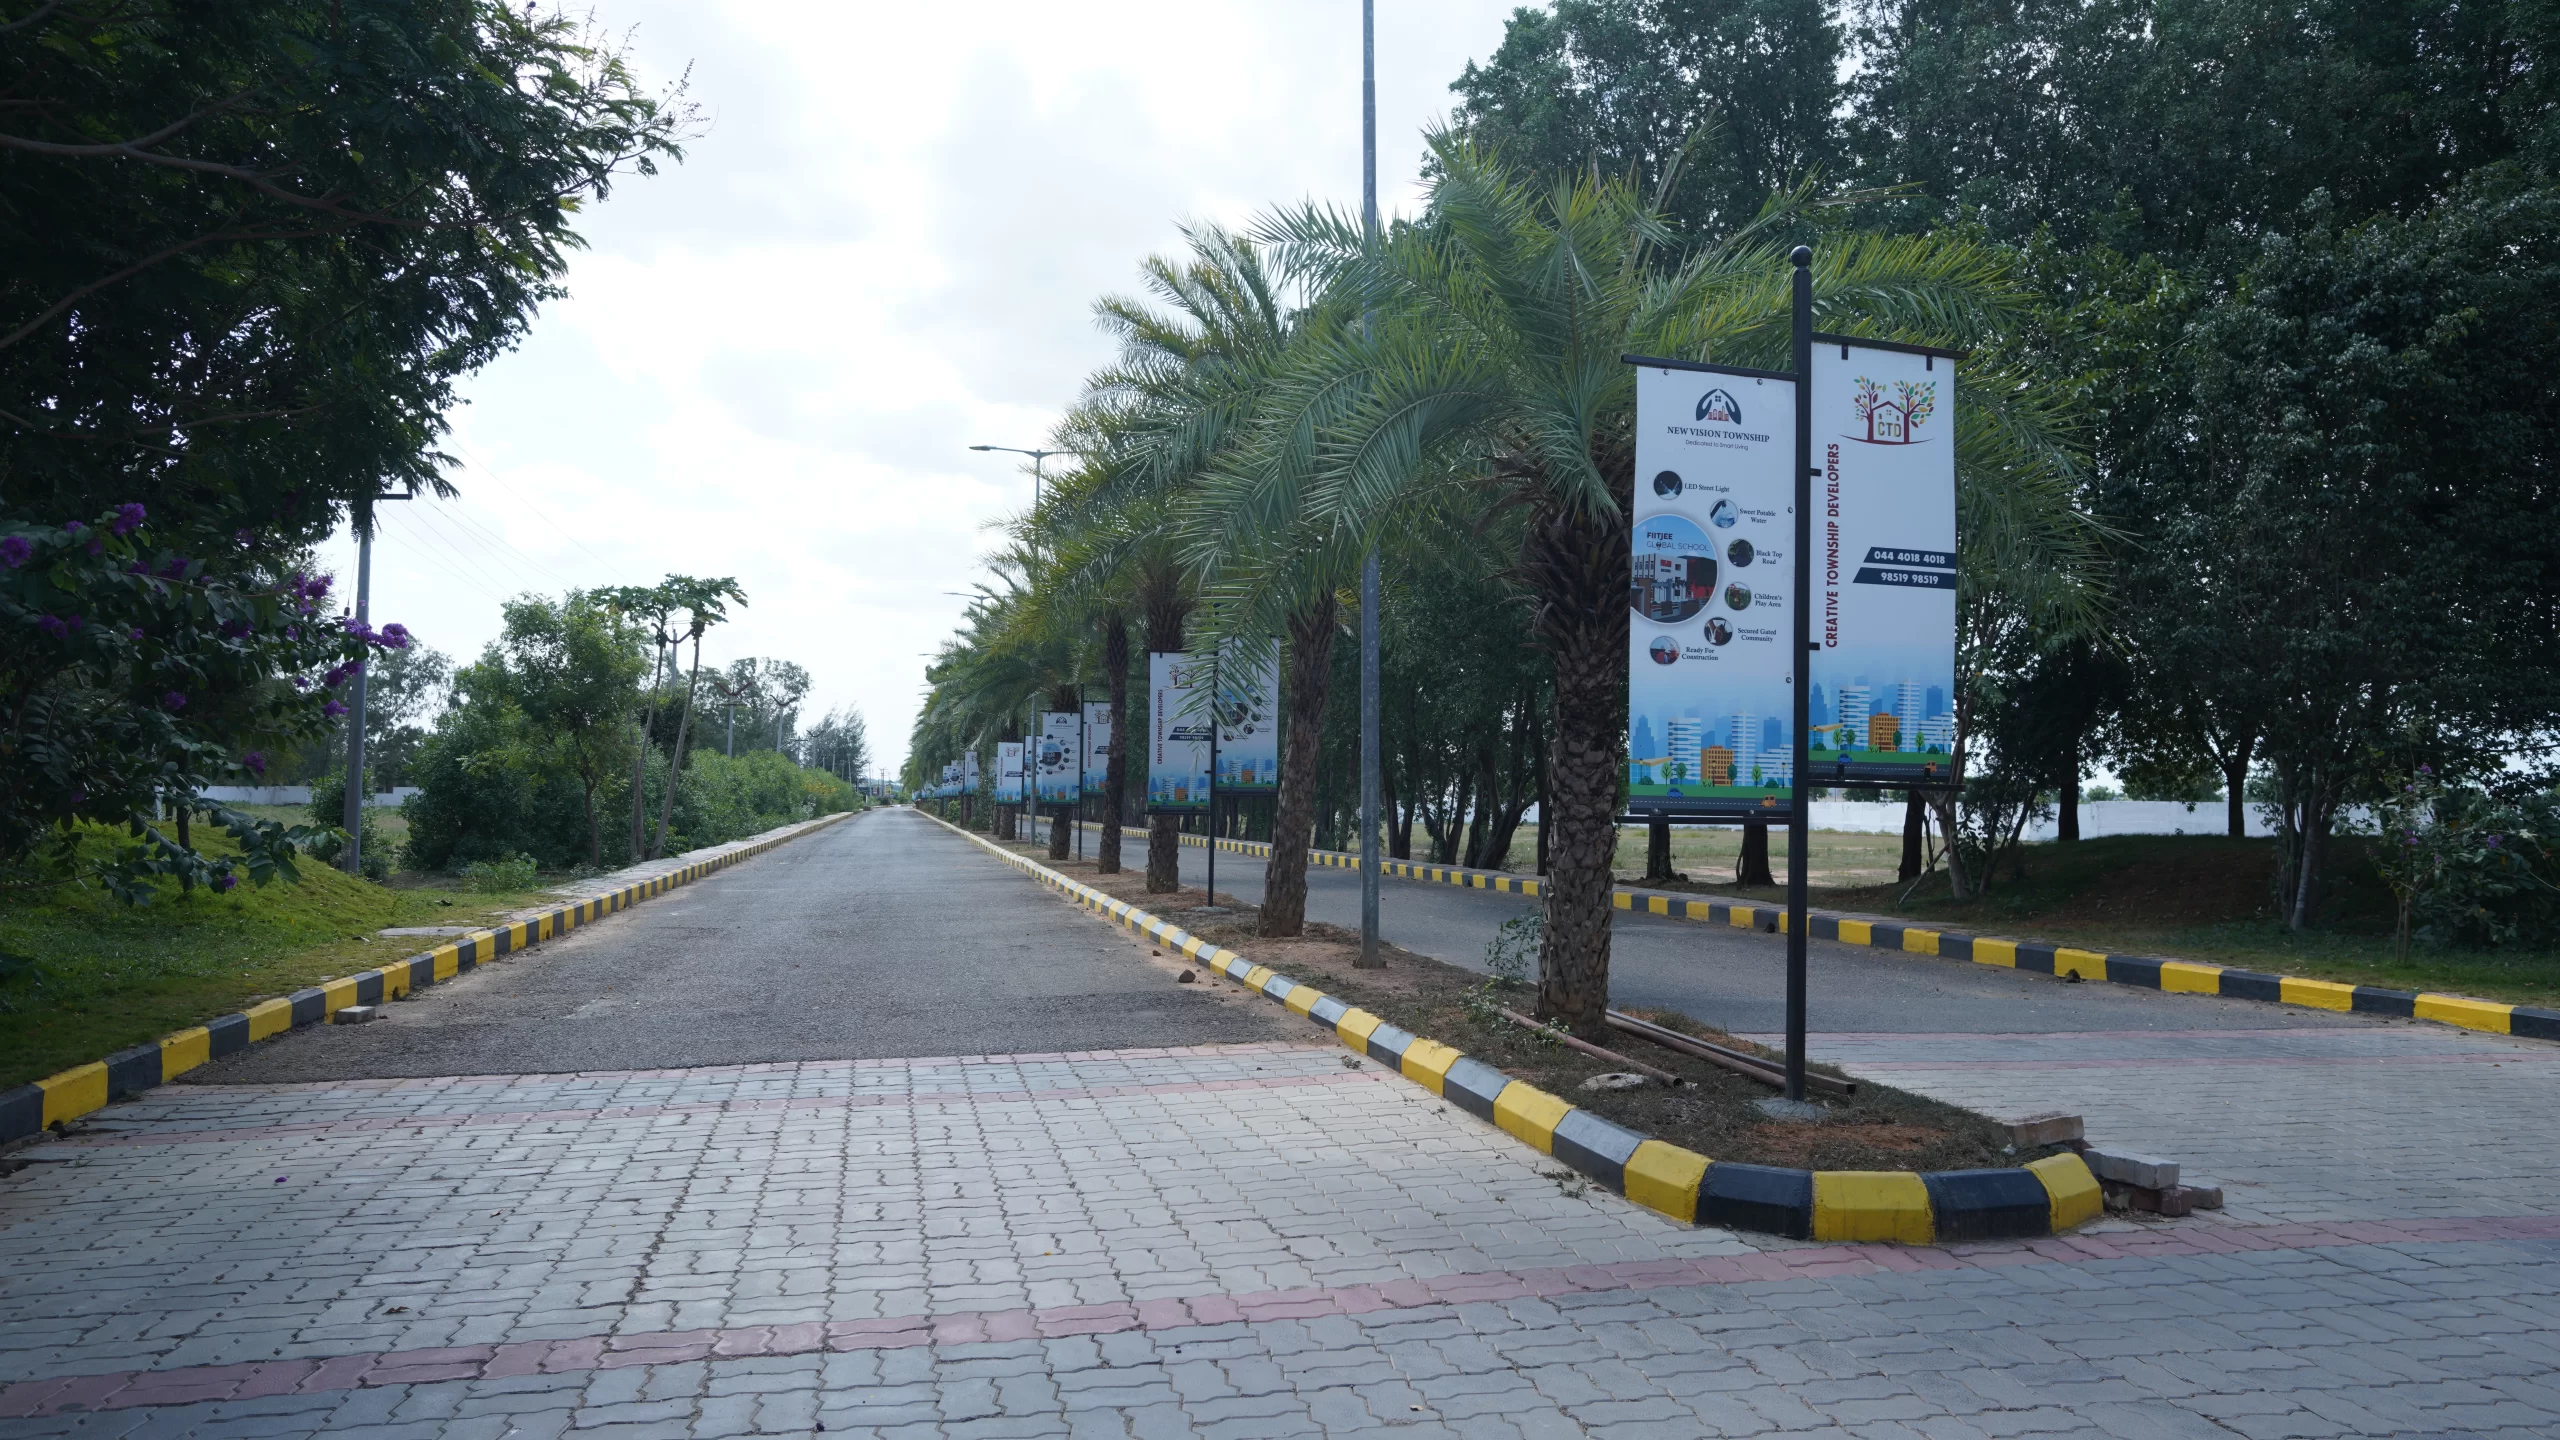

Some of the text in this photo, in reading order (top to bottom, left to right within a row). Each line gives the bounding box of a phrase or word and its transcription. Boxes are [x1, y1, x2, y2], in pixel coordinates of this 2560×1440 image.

[1878, 422, 1902, 437] CTD
[1667, 426, 1770, 443] NEW VISION TOWNSHIP
[1685, 439, 1712, 447] Dedicated
[1734, 443, 1749, 451] Living
[1715, 485, 1730, 493] Light
[1739, 508, 1776, 517] Sweet Potable
[1750, 516, 1767, 524] Water
[1646, 532, 1673, 540] FIITJEE
[1677, 542, 1710, 552] SCHOOL
[1825, 443, 1839, 648] CREATIVE TOWNSHIP DEVELOPERS
[1874, 550, 1946, 564] 044 4018 4018
[1881, 572, 1939, 585] 98519 98519
[1754, 593, 1782, 601] Children's
[1755, 600, 1768, 608] Play
[1737, 627, 1759, 635] Secured
[1741, 635, 1774, 643] Community
[1681, 653, 1719, 661] Construction
